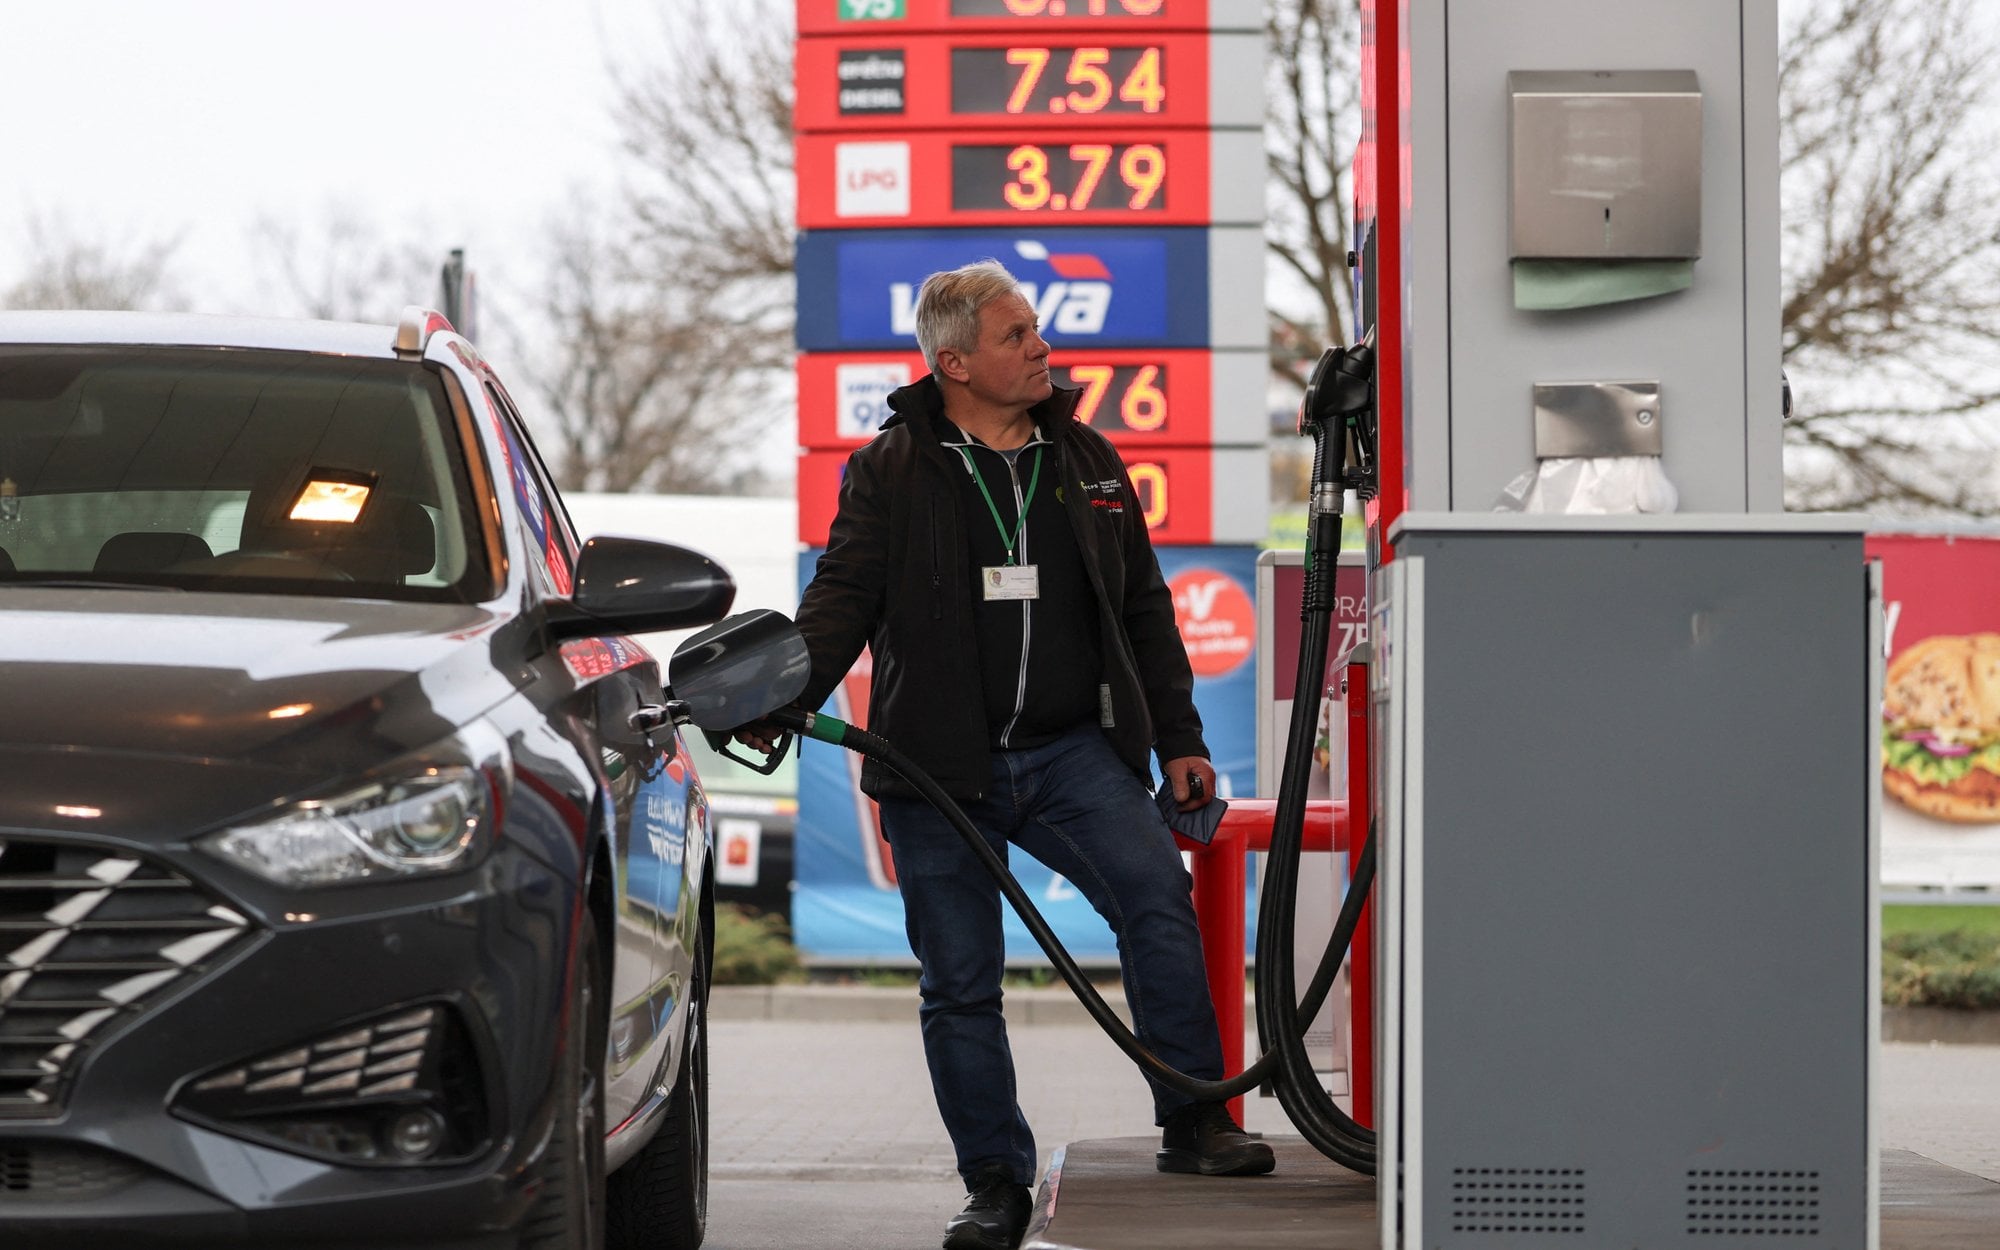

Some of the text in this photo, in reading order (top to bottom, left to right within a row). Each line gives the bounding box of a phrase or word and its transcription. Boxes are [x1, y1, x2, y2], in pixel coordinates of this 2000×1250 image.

[1006, 47, 1166, 114] 7.54
[847, 173, 898, 191] LPG
[1004, 144, 1167, 211] 3.79
[889, 281, 1113, 335] vva
